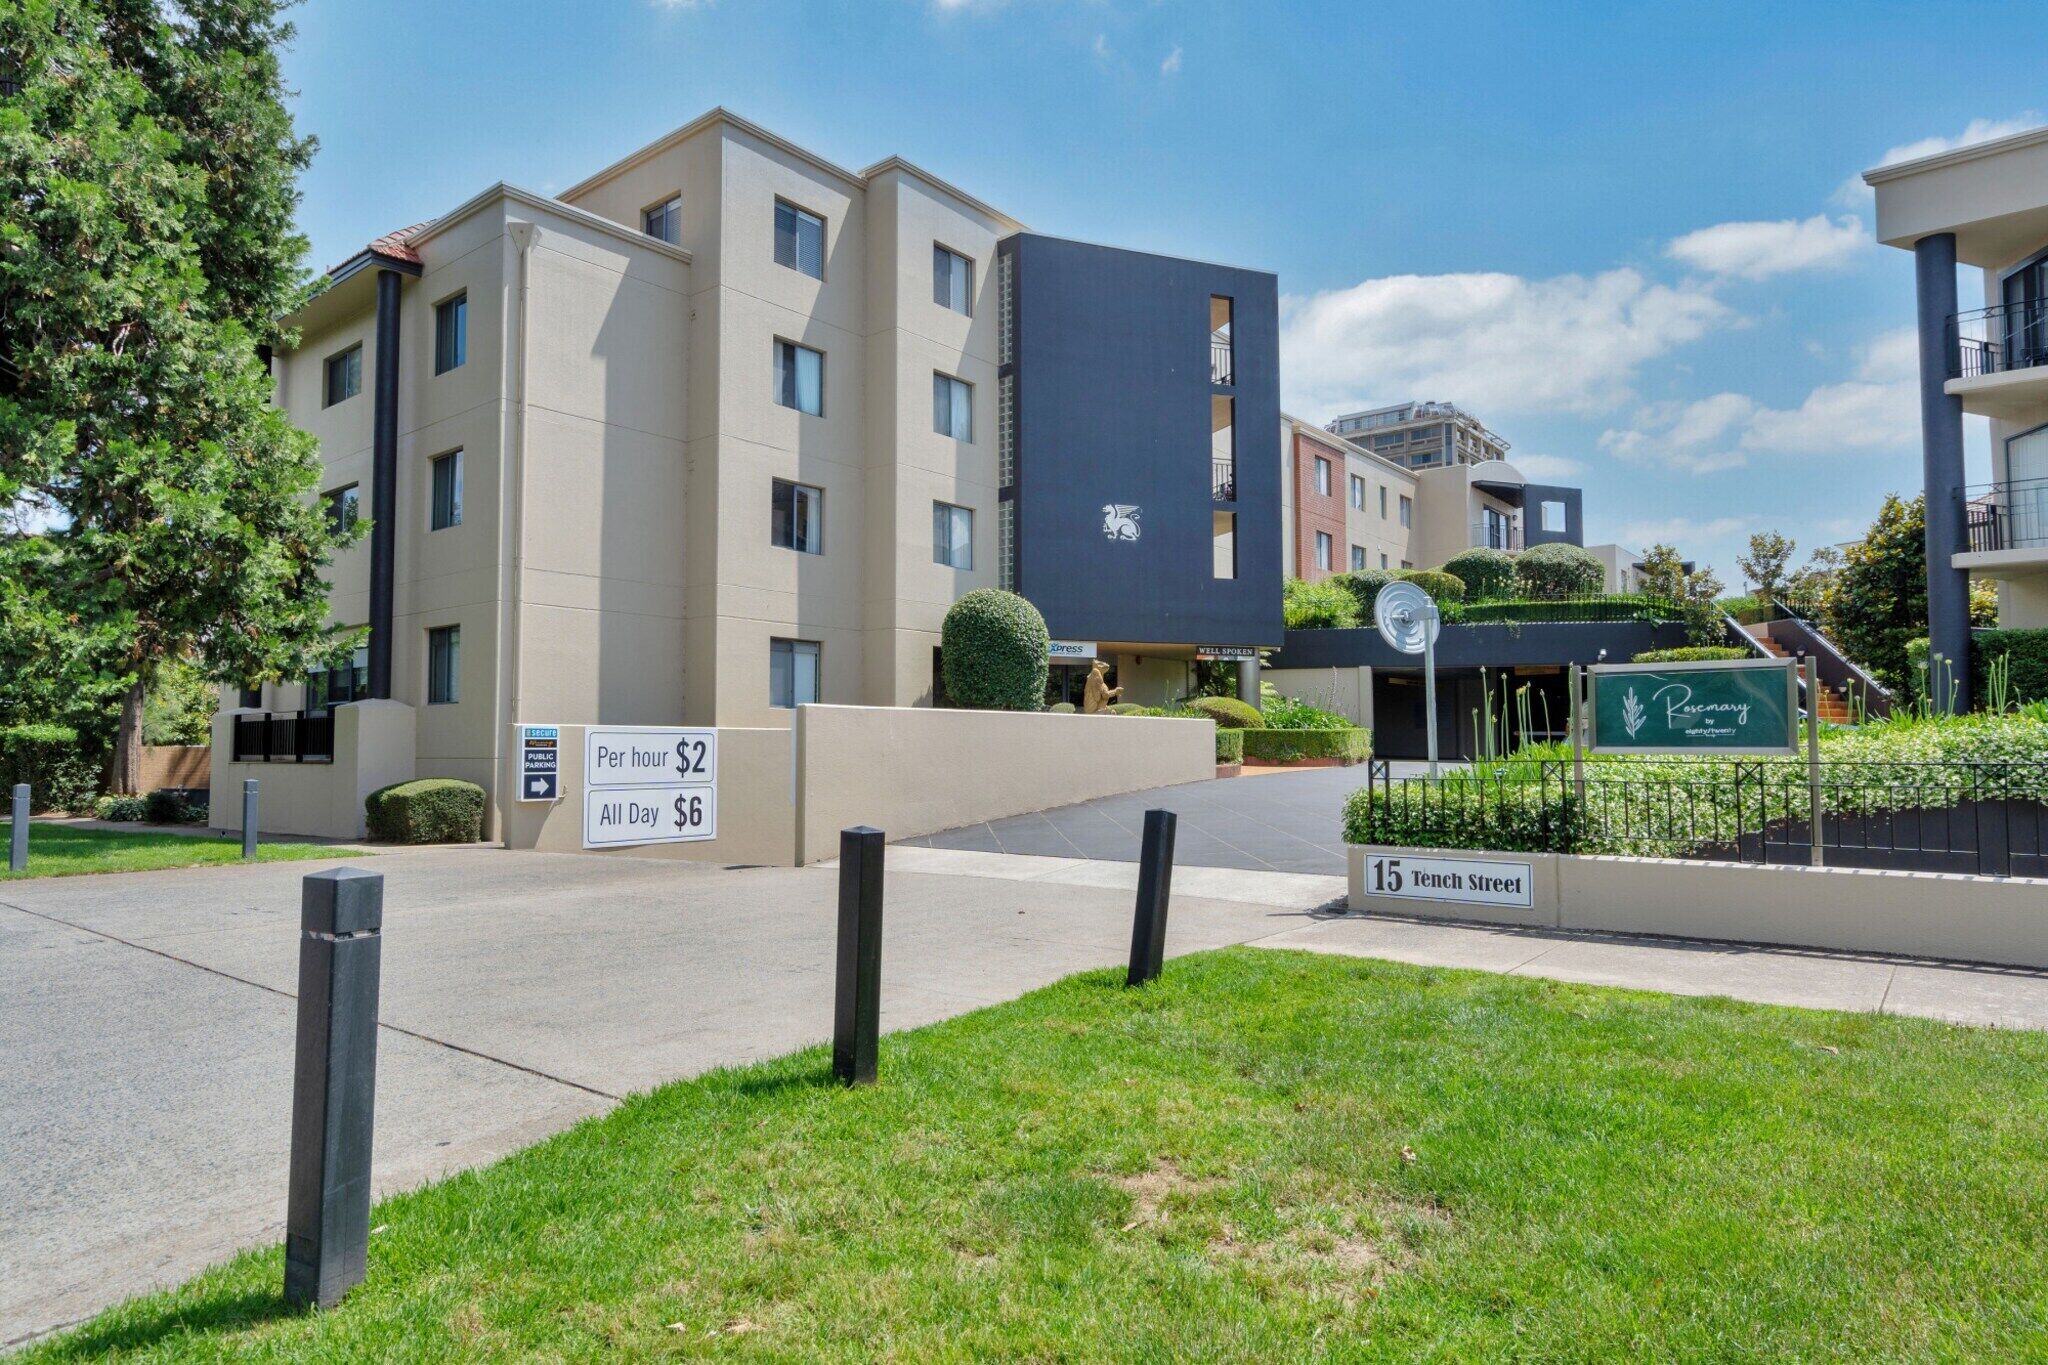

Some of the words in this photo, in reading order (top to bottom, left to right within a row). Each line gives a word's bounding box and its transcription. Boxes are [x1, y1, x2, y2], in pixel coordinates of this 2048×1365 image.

[1199, 647, 1220, 655] WELL
[1222, 647, 1253, 656] SPOKEN
[1652, 683, 1751, 729] Rosemary
[1705, 718, 1715, 726] by
[531, 729, 557, 737] secure
[527, 753, 554, 761] PUBLIC
[597, 746, 626, 768] Per
[631, 746, 669, 768] hour
[675, 737, 706, 778] $2
[525, 761, 556, 769] PARKING
[600, 803, 622, 826] All
[629, 802, 659, 828] Day
[674, 793, 702, 832] $6
[1374, 859, 1403, 893] 15
[1412, 869, 1463, 890] Tench
[1468, 873, 1522, 894] Street
